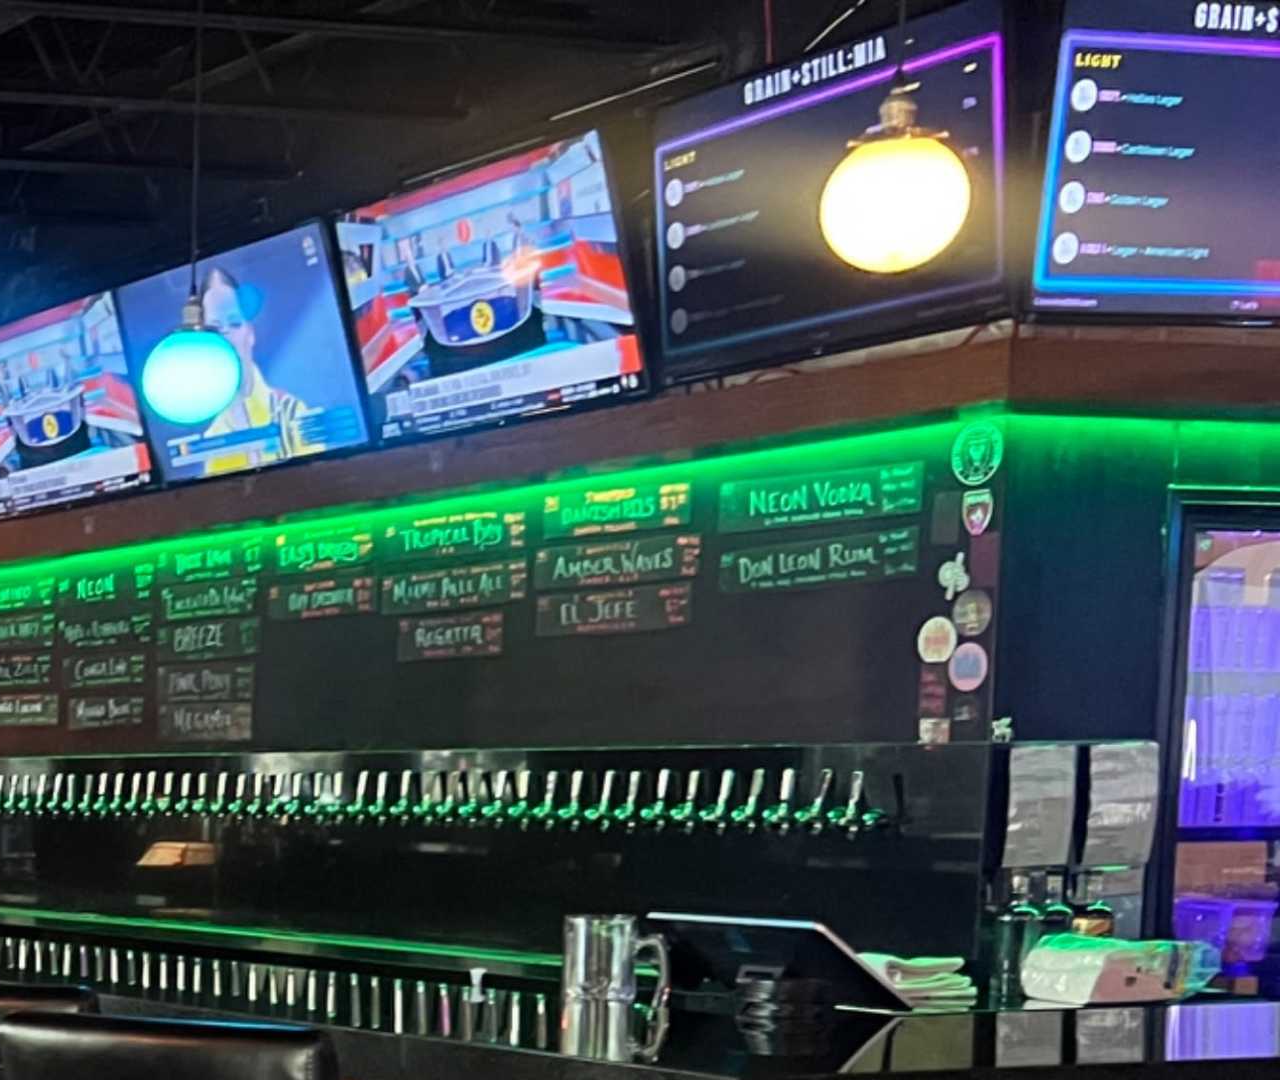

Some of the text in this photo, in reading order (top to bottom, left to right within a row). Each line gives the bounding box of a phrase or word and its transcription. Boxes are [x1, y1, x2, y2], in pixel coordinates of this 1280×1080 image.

[743, 35, 887, 106] GRAIN+STILL:MIA
[1074, 52, 1123, 69] LIGHT
[749, 481, 876, 516] NEON VODKA
[561, 504, 620, 526] DANISH
[399, 524, 470, 552] TROPICAL
[279, 542, 315, 569] EASY
[553, 541, 674, 581] AMBER WAVES
[739, 543, 880, 584] DON LEON RUM
[76, 573, 115, 599] NEON
[440, 576, 474, 601] PALE
[477, 572, 503, 599] ALE
[560, 601, 638, 626] EL JEFE
[414, 624, 483, 648] REGATTA
